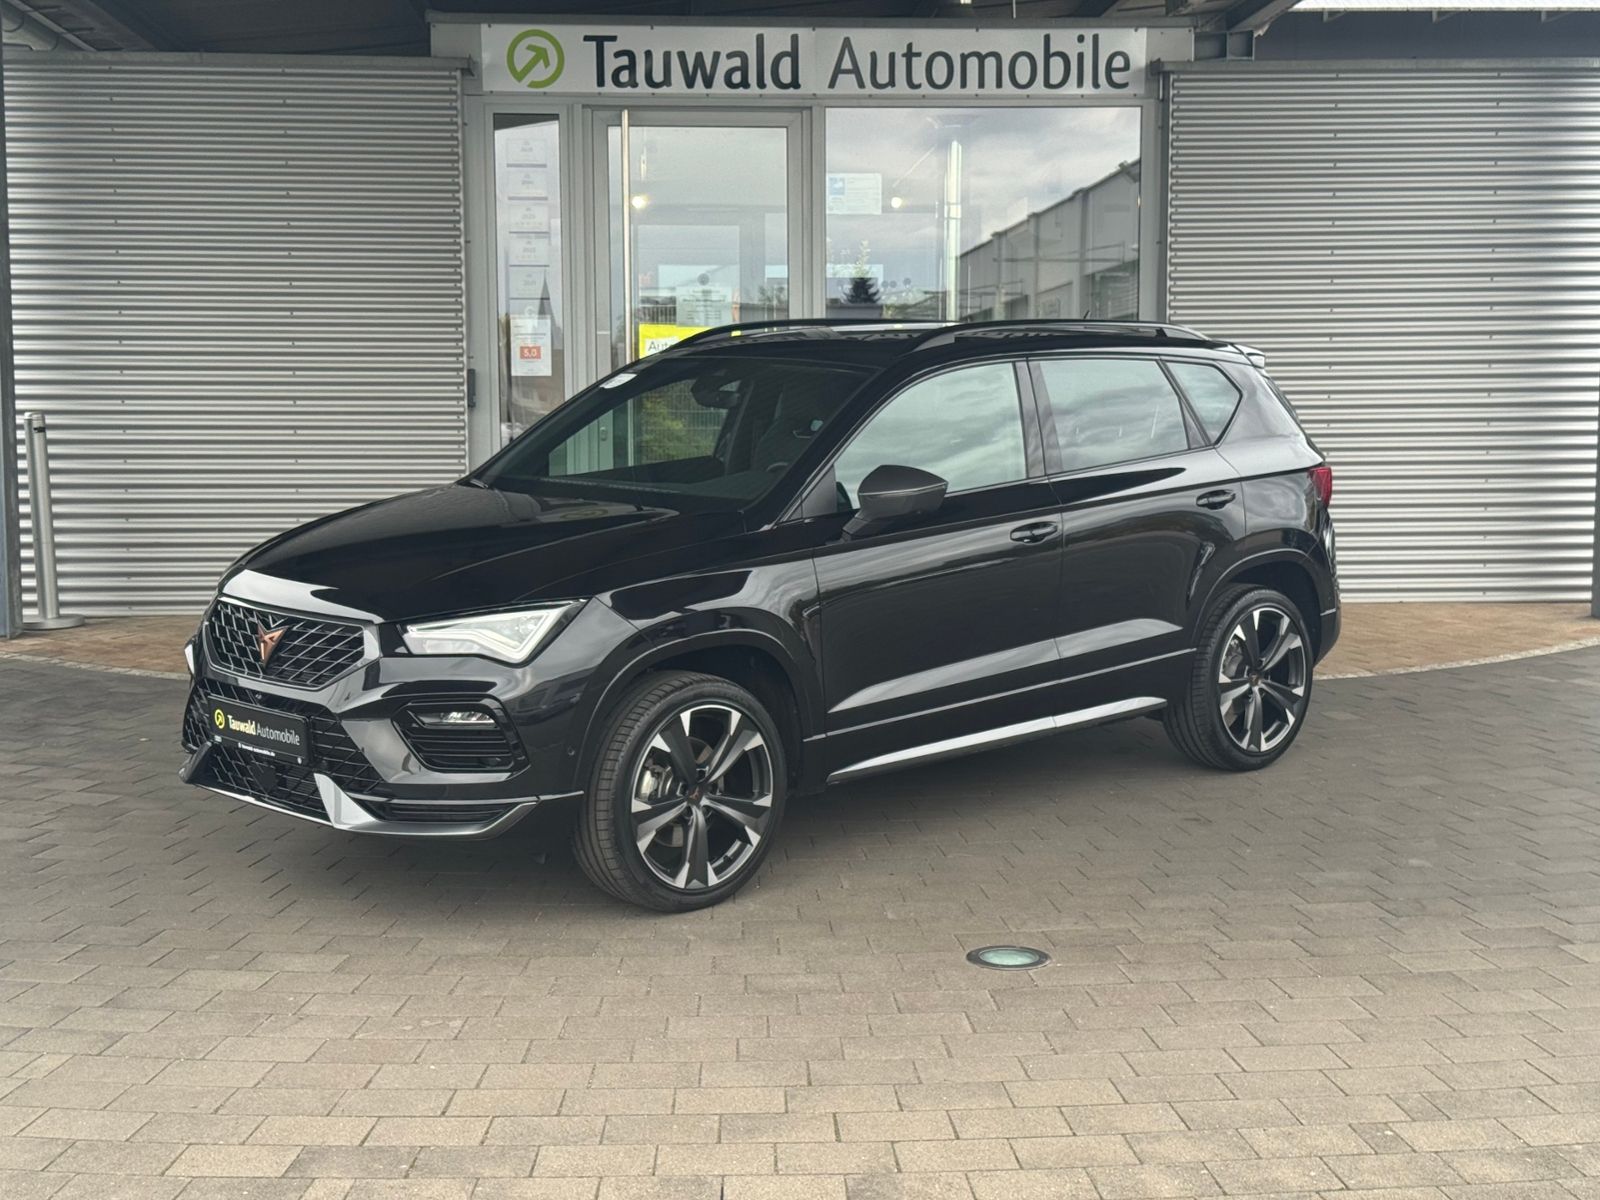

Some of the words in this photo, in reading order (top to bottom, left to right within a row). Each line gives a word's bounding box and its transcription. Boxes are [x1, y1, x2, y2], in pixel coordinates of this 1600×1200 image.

[583, 33, 801, 90] Tauwald
[827, 33, 1131, 90] Automobile
[227, 714, 256, 735] Tauwald
[257, 723, 300, 745] Automobile
